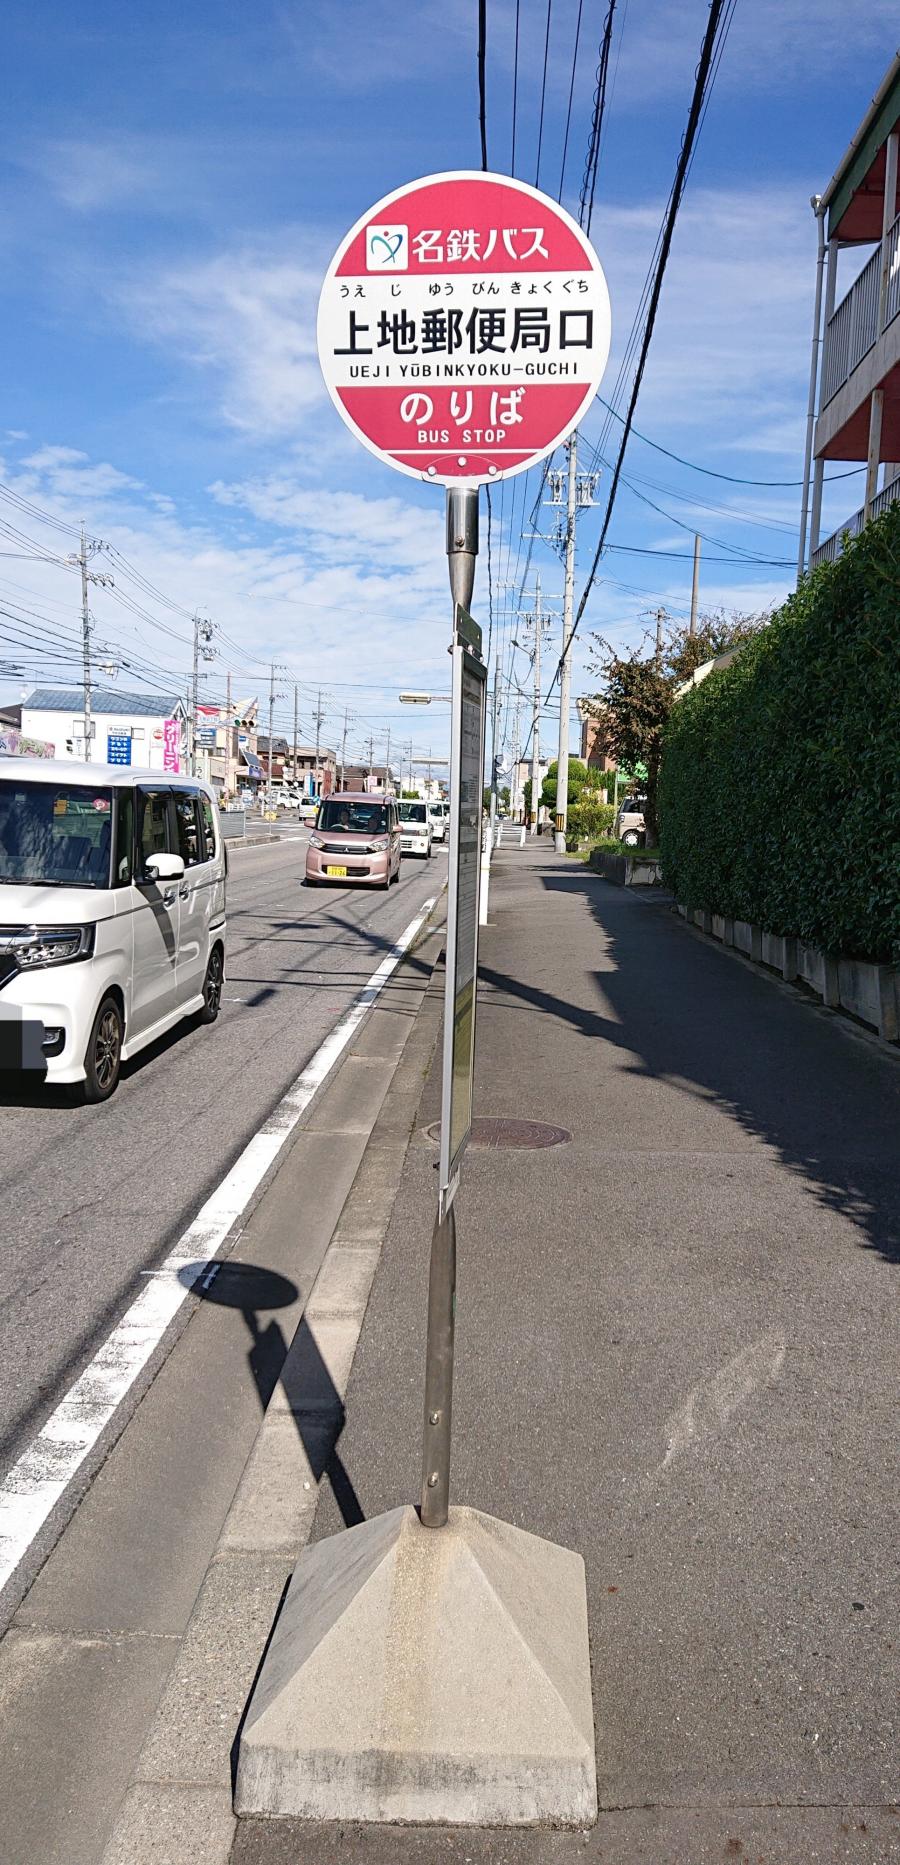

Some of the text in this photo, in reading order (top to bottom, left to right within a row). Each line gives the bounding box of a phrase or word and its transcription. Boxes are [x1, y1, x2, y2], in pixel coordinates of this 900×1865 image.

[412, 228, 549, 263] 名鉄バス
[339, 279, 589, 298] うえ じ ゆう びん きょく ぐち
[333, 306, 594, 356] 上地郵便局口
[350, 365, 390, 378] UEJI
[399, 387, 527, 426] のりば
[417, 429, 506, 443] BUS STOP
